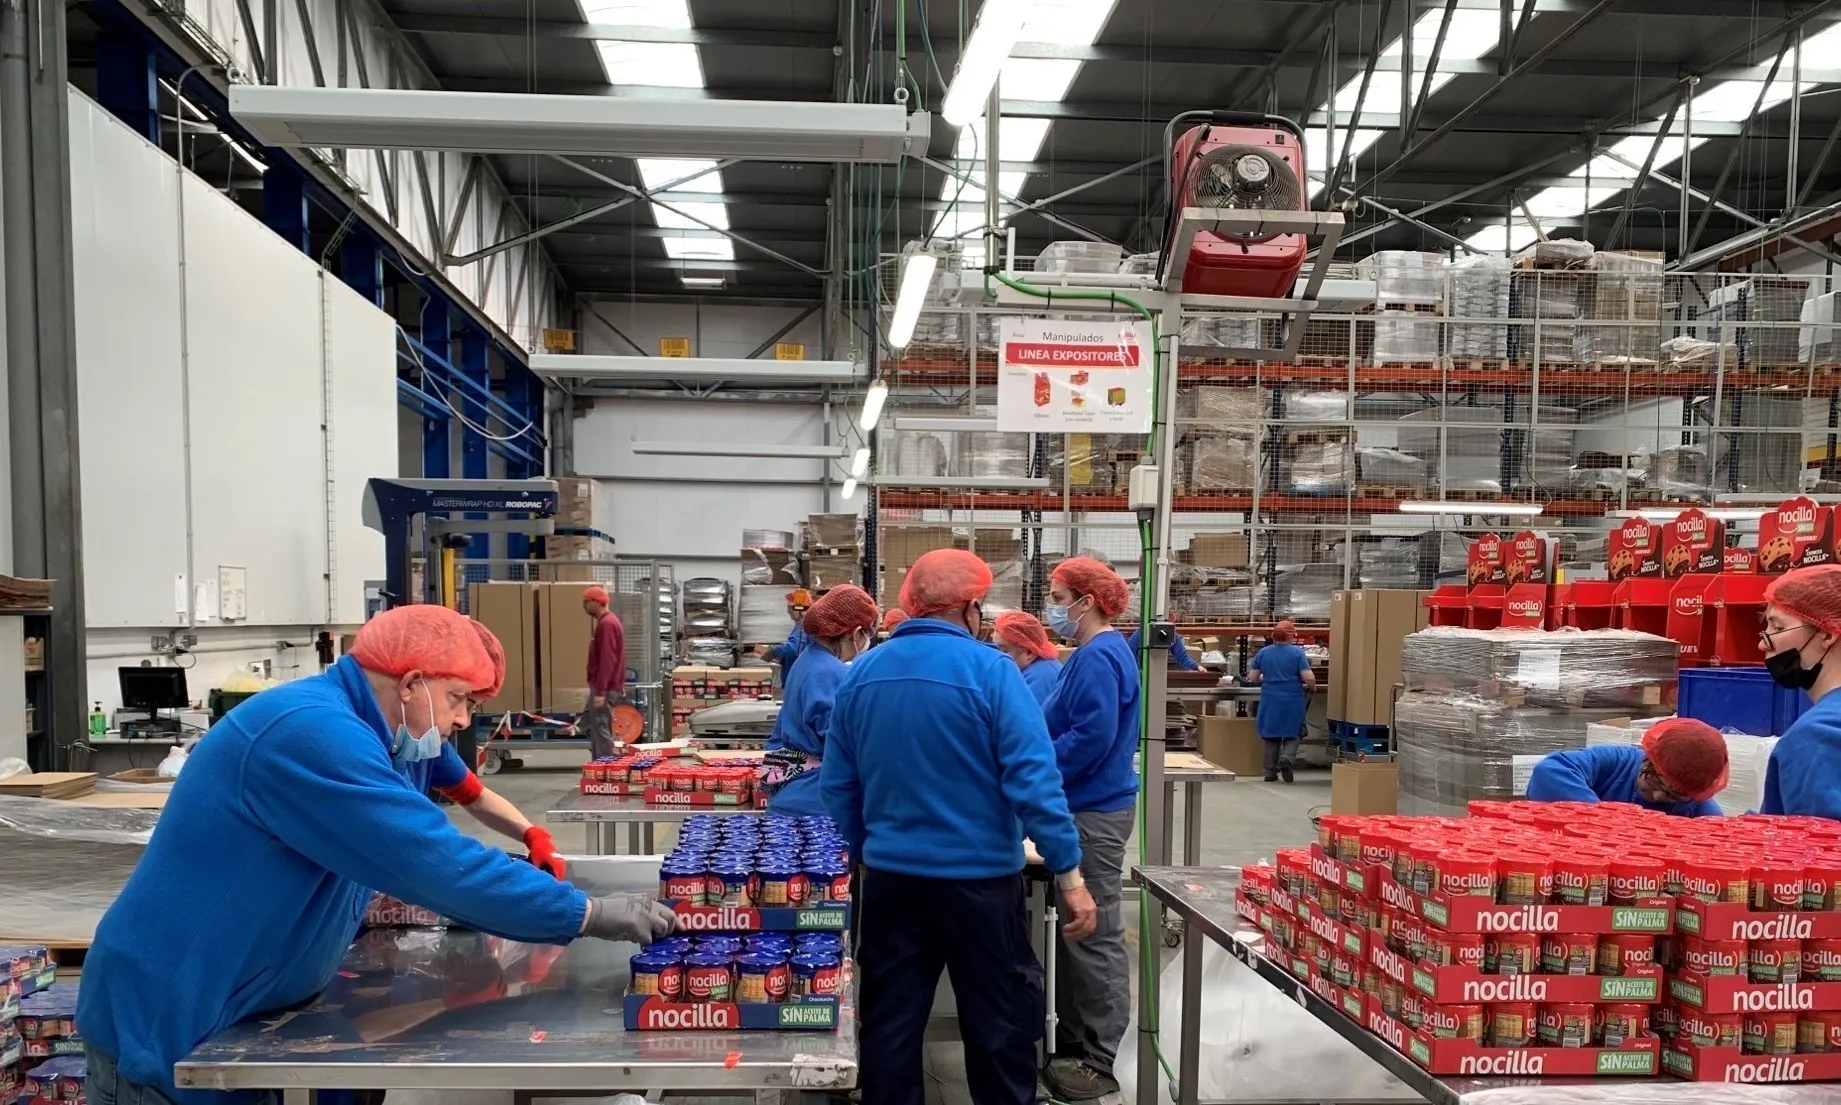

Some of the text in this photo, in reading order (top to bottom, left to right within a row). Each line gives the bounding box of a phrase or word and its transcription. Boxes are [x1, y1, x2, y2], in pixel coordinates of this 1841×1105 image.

[1042, 331, 1104, 343] Manipulados
[1018, 348, 1127, 362] LINEA EXPOSITORES
[1778, 506, 1813, 523] nocilla
[1623, 524, 1647, 539] nocilla
[1677, 517, 1703, 533] nocilla
[1479, 540, 1497, 552] nocilla
[1516, 538, 1534, 550] nocilla
[1724, 551, 1748, 563] ocilla
[1509, 600, 1538, 610] nocilla
[585, 783, 619, 793] nocilla
[655, 792, 691, 803] nocilla
[1312, 857, 1340, 884] nocilla
[670, 882, 705, 894] nocilla
[1443, 873, 1489, 888] nocilla
[1609, 876, 1656, 891] nocilla
[1684, 877, 1715, 894] ocilla
[1271, 887, 1294, 914] nocilla
[1382, 881, 1415, 914] nocilla
[369, 904, 428, 925] nocilla
[678, 907, 750, 930] nocilla
[1236, 899, 1256, 924] nocilla
[1477, 905, 1559, 931] nocilla
[819, 918, 843, 926] PALMA
[1311, 916, 1339, 944] nocilla
[1637, 919, 1665, 927] PALMA
[1732, 914, 1812, 939] nocilla
[1267, 942, 1289, 971] nocilla
[1373, 946, 1405, 983] nocilla
[1686, 950, 1732, 966] nocilla
[1802, 951, 1841, 965] ocilla
[690, 973, 726, 987] nocilla
[1464, 975, 1546, 1001] nocilla
[1311, 973, 1338, 1006] nocilla
[1626, 988, 1653, 997] PALMA
[1733, 983, 1813, 1011] nocilla
[648, 1003, 728, 1028] nocilla
[803, 1014, 831, 1022] PALMA
[1423, 1012, 1454, 1029] ocilla
[1370, 1011, 1403, 1049] nocilla
[1681, 1019, 1713, 1037] ocilla
[1460, 1050, 1543, 1074] nocilla
[1622, 1060, 1649, 1069] PALMA
[1724, 1057, 1805, 1083] nocilla
